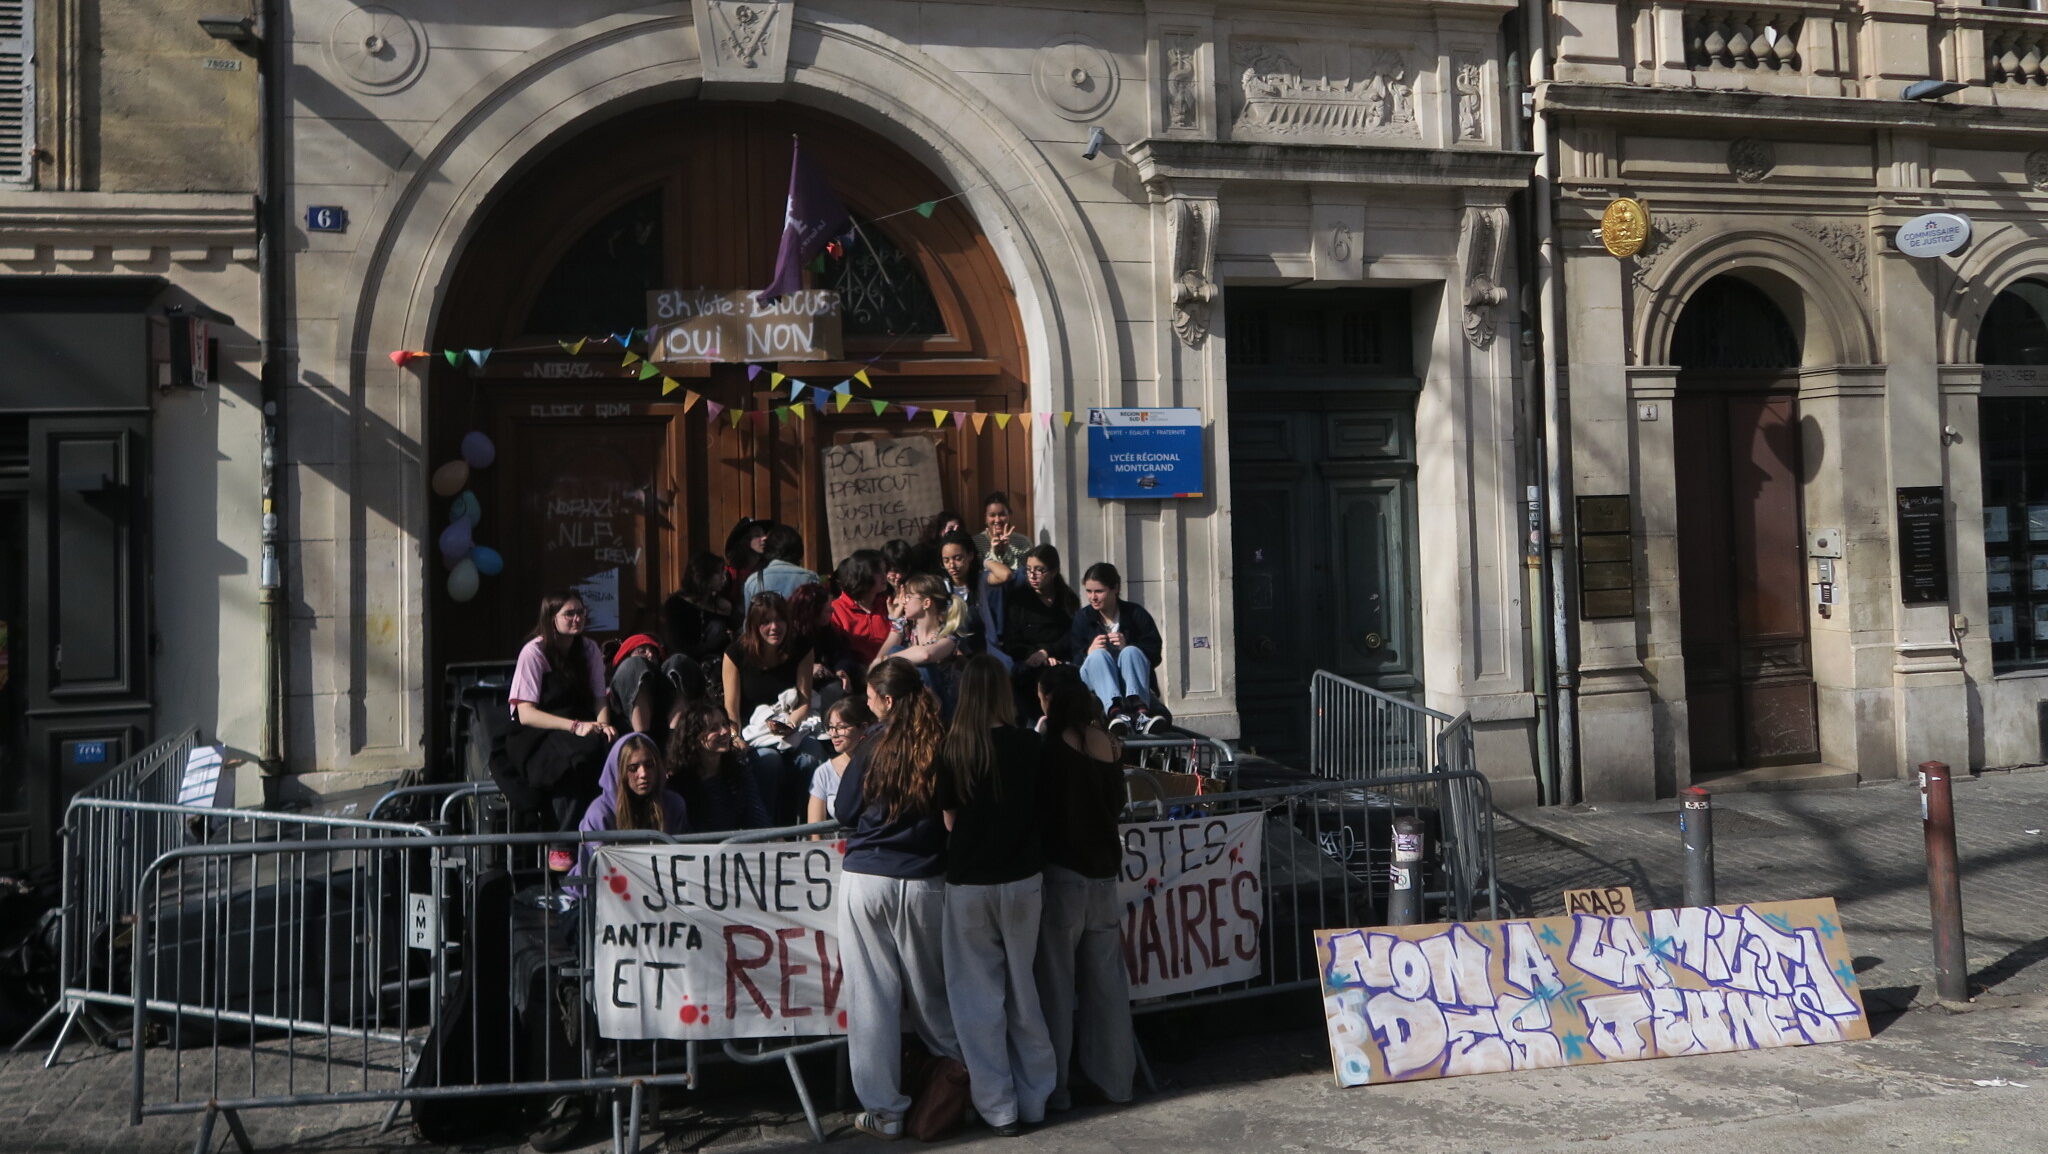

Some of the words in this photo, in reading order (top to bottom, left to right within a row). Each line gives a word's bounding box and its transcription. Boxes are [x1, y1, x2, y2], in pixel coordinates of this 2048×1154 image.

[317, 208, 332, 229] 6
[1903, 226, 1960, 241] COMMISSAIRE
[1910, 239, 1920, 247] DE
[1922, 235, 1954, 245] JUSTICE
[657, 291, 691, 318] 8h
[746, 322, 814, 356] NON
[828, 446, 913, 475] POLICE
[1110, 452, 1135, 462] LYCÉE
[1136, 452, 1181, 461] RÉGIONAL
[1115, 464, 1174, 472] MONTGRAND
[829, 473, 919, 498] PARTOUT
[833, 500, 907, 520] JUSTICE
[643, 848, 832, 912] JEUNES
[1117, 820, 1228, 882] STES
[1571, 888, 1626, 915] ACAB
[602, 921, 702, 950] ANTIFA
[1326, 923, 1498, 1008] NON
[1502, 920, 1567, 1000] A
[1567, 913, 1675, 990] LA
[612, 958, 686, 1010] ET
[1363, 991, 1565, 1078] DES
[1577, 984, 1840, 1060] JEUNES
